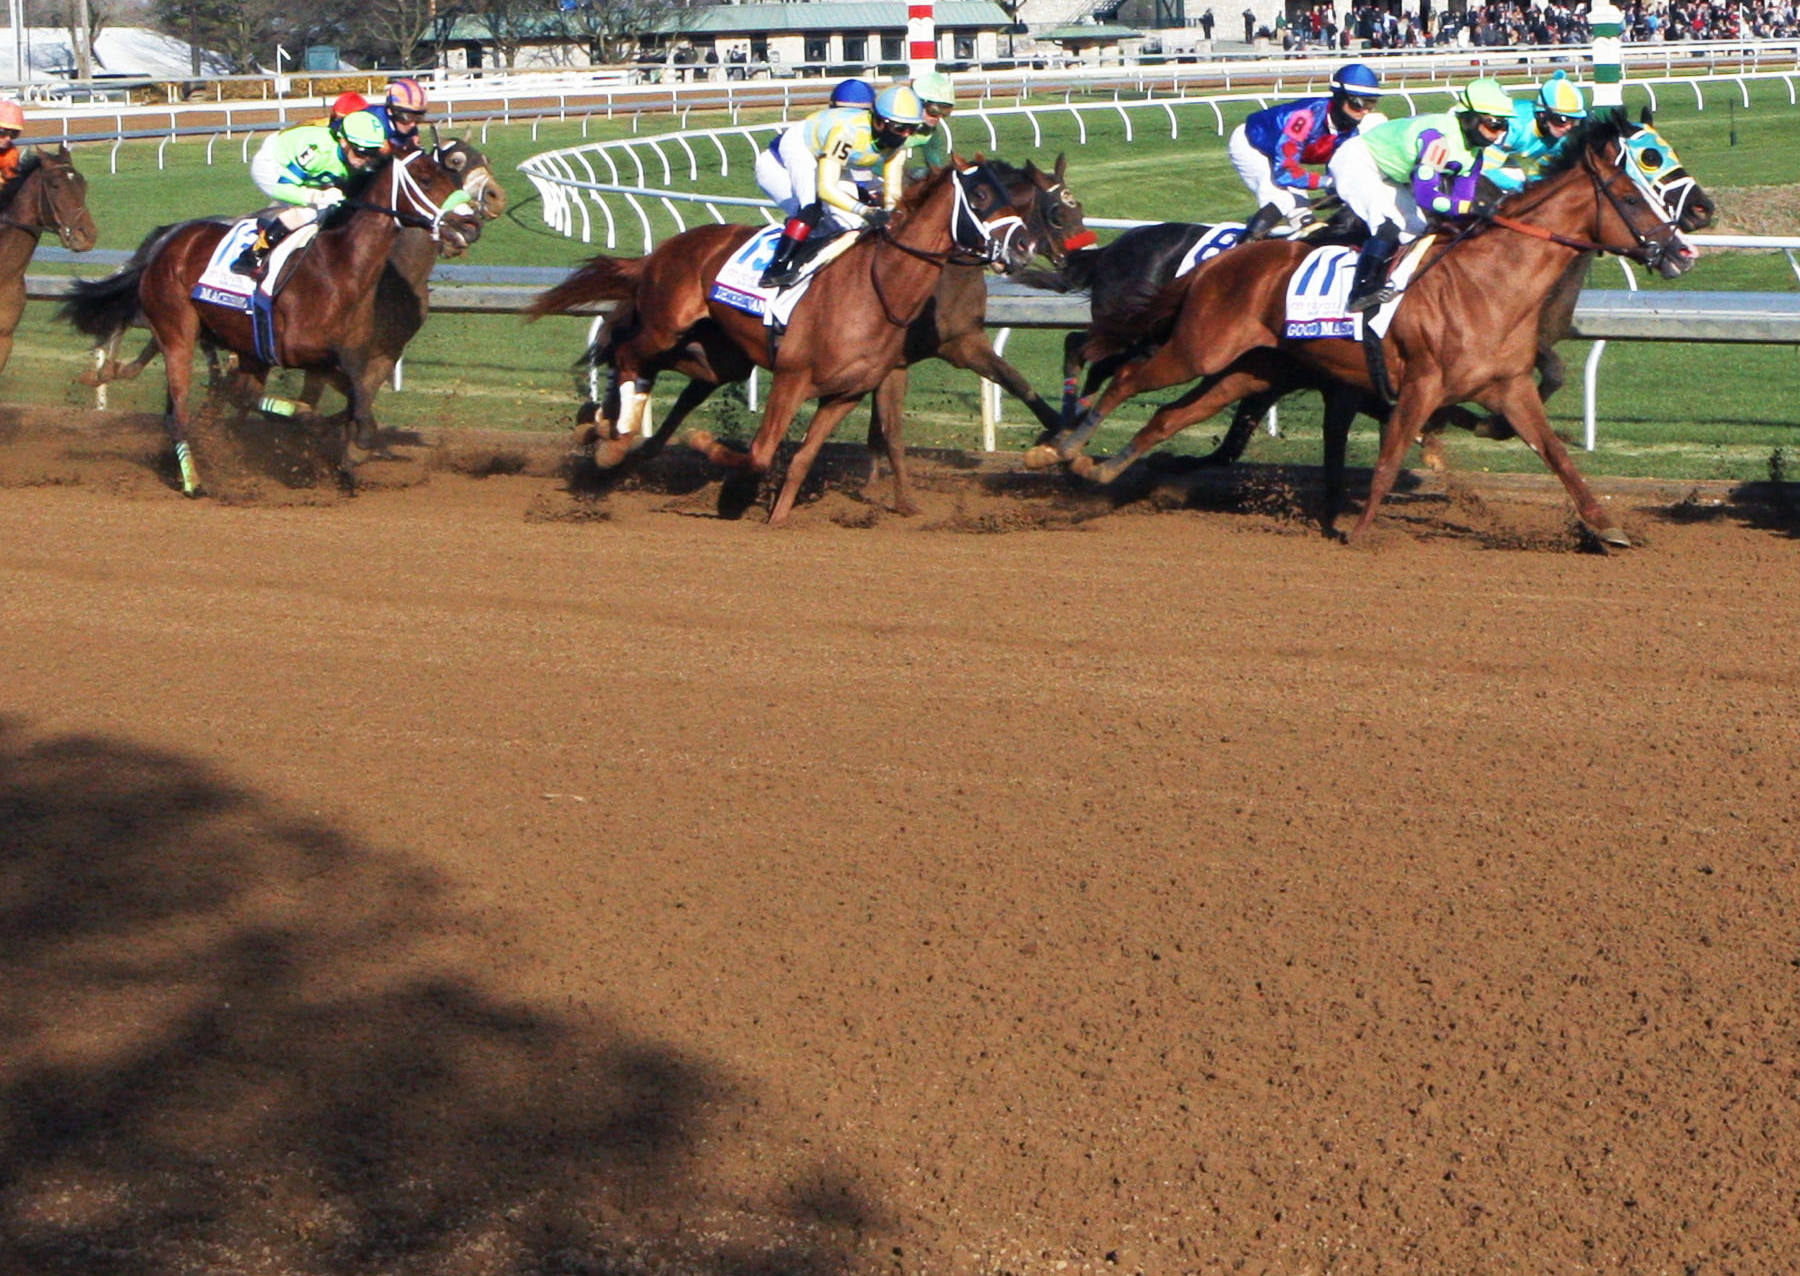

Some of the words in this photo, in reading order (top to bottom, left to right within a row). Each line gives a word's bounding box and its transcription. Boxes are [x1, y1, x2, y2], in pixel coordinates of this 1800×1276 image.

[1291, 116, 1306, 132] 8
[831, 140, 852, 160] 15
[1194, 227, 1246, 265] 8
